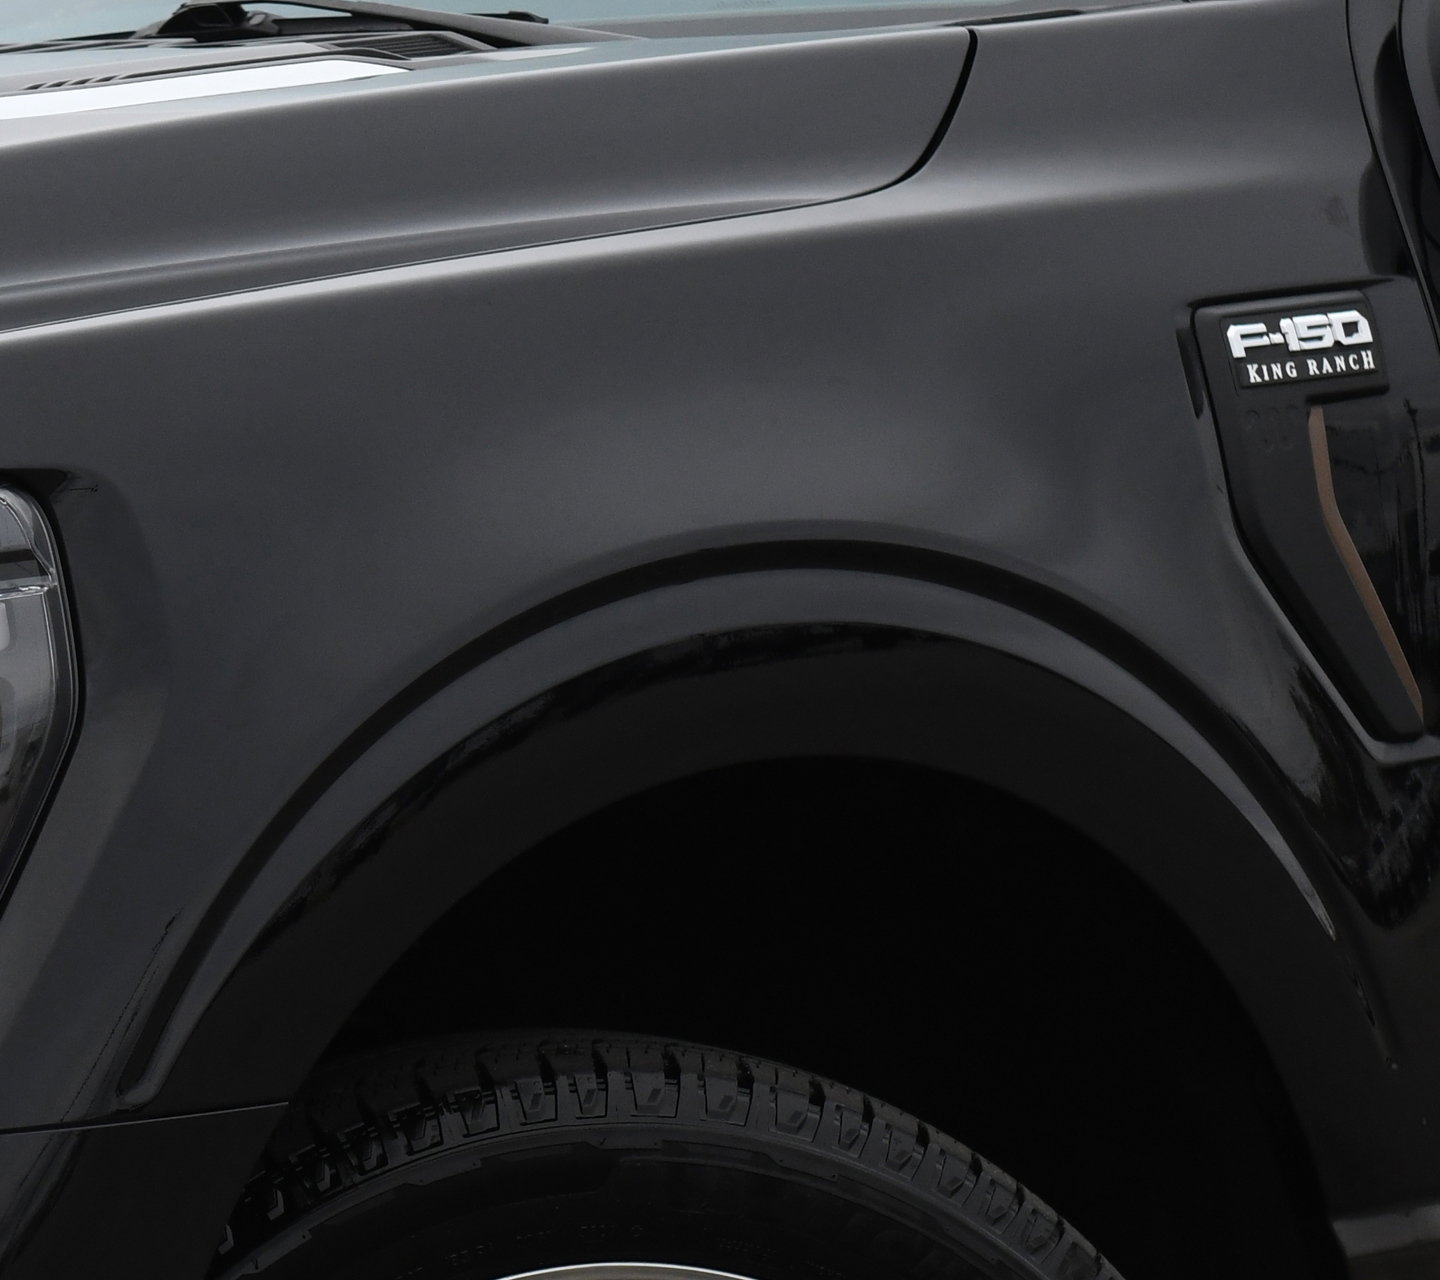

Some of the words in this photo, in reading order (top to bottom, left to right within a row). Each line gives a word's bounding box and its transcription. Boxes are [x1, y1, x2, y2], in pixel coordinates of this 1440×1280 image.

[1226, 309, 1374, 358] F-150
[1246, 361, 1298, 384] KING
[1306, 350, 1376, 376] RANCH
